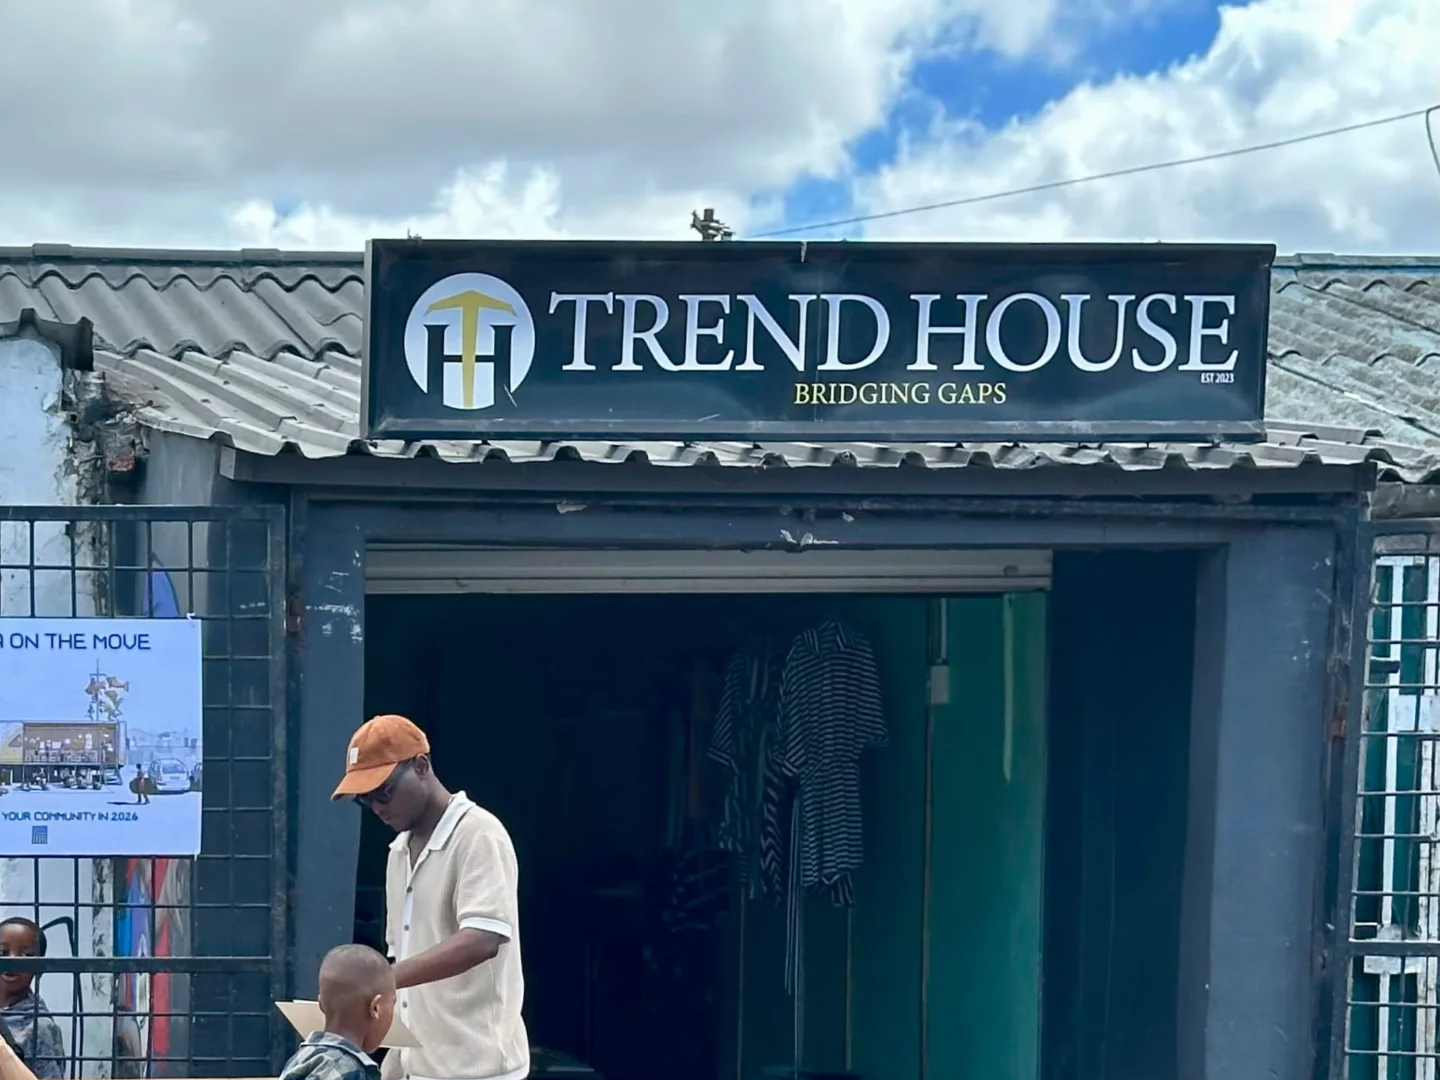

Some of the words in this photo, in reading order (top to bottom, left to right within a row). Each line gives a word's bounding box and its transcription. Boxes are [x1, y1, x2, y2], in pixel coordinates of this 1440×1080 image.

[549, 290, 891, 373] TREND
[910, 291, 1239, 373] HOUSE
[1200, 373, 1214, 383] EST
[1215, 373, 1235, 383] 2023
[793, 382, 931, 404] BRIDGING
[938, 382, 1007, 404] GAPS
[10, 632, 40, 649] ON
[44, 633, 87, 649] THE
[93, 633, 152, 650] MOVE
[2, 811, 31, 821] YOUR
[33, 811, 96, 822] COMMUNITY
[98, 812, 109, 821] IN
[111, 811, 139, 821] 2026
